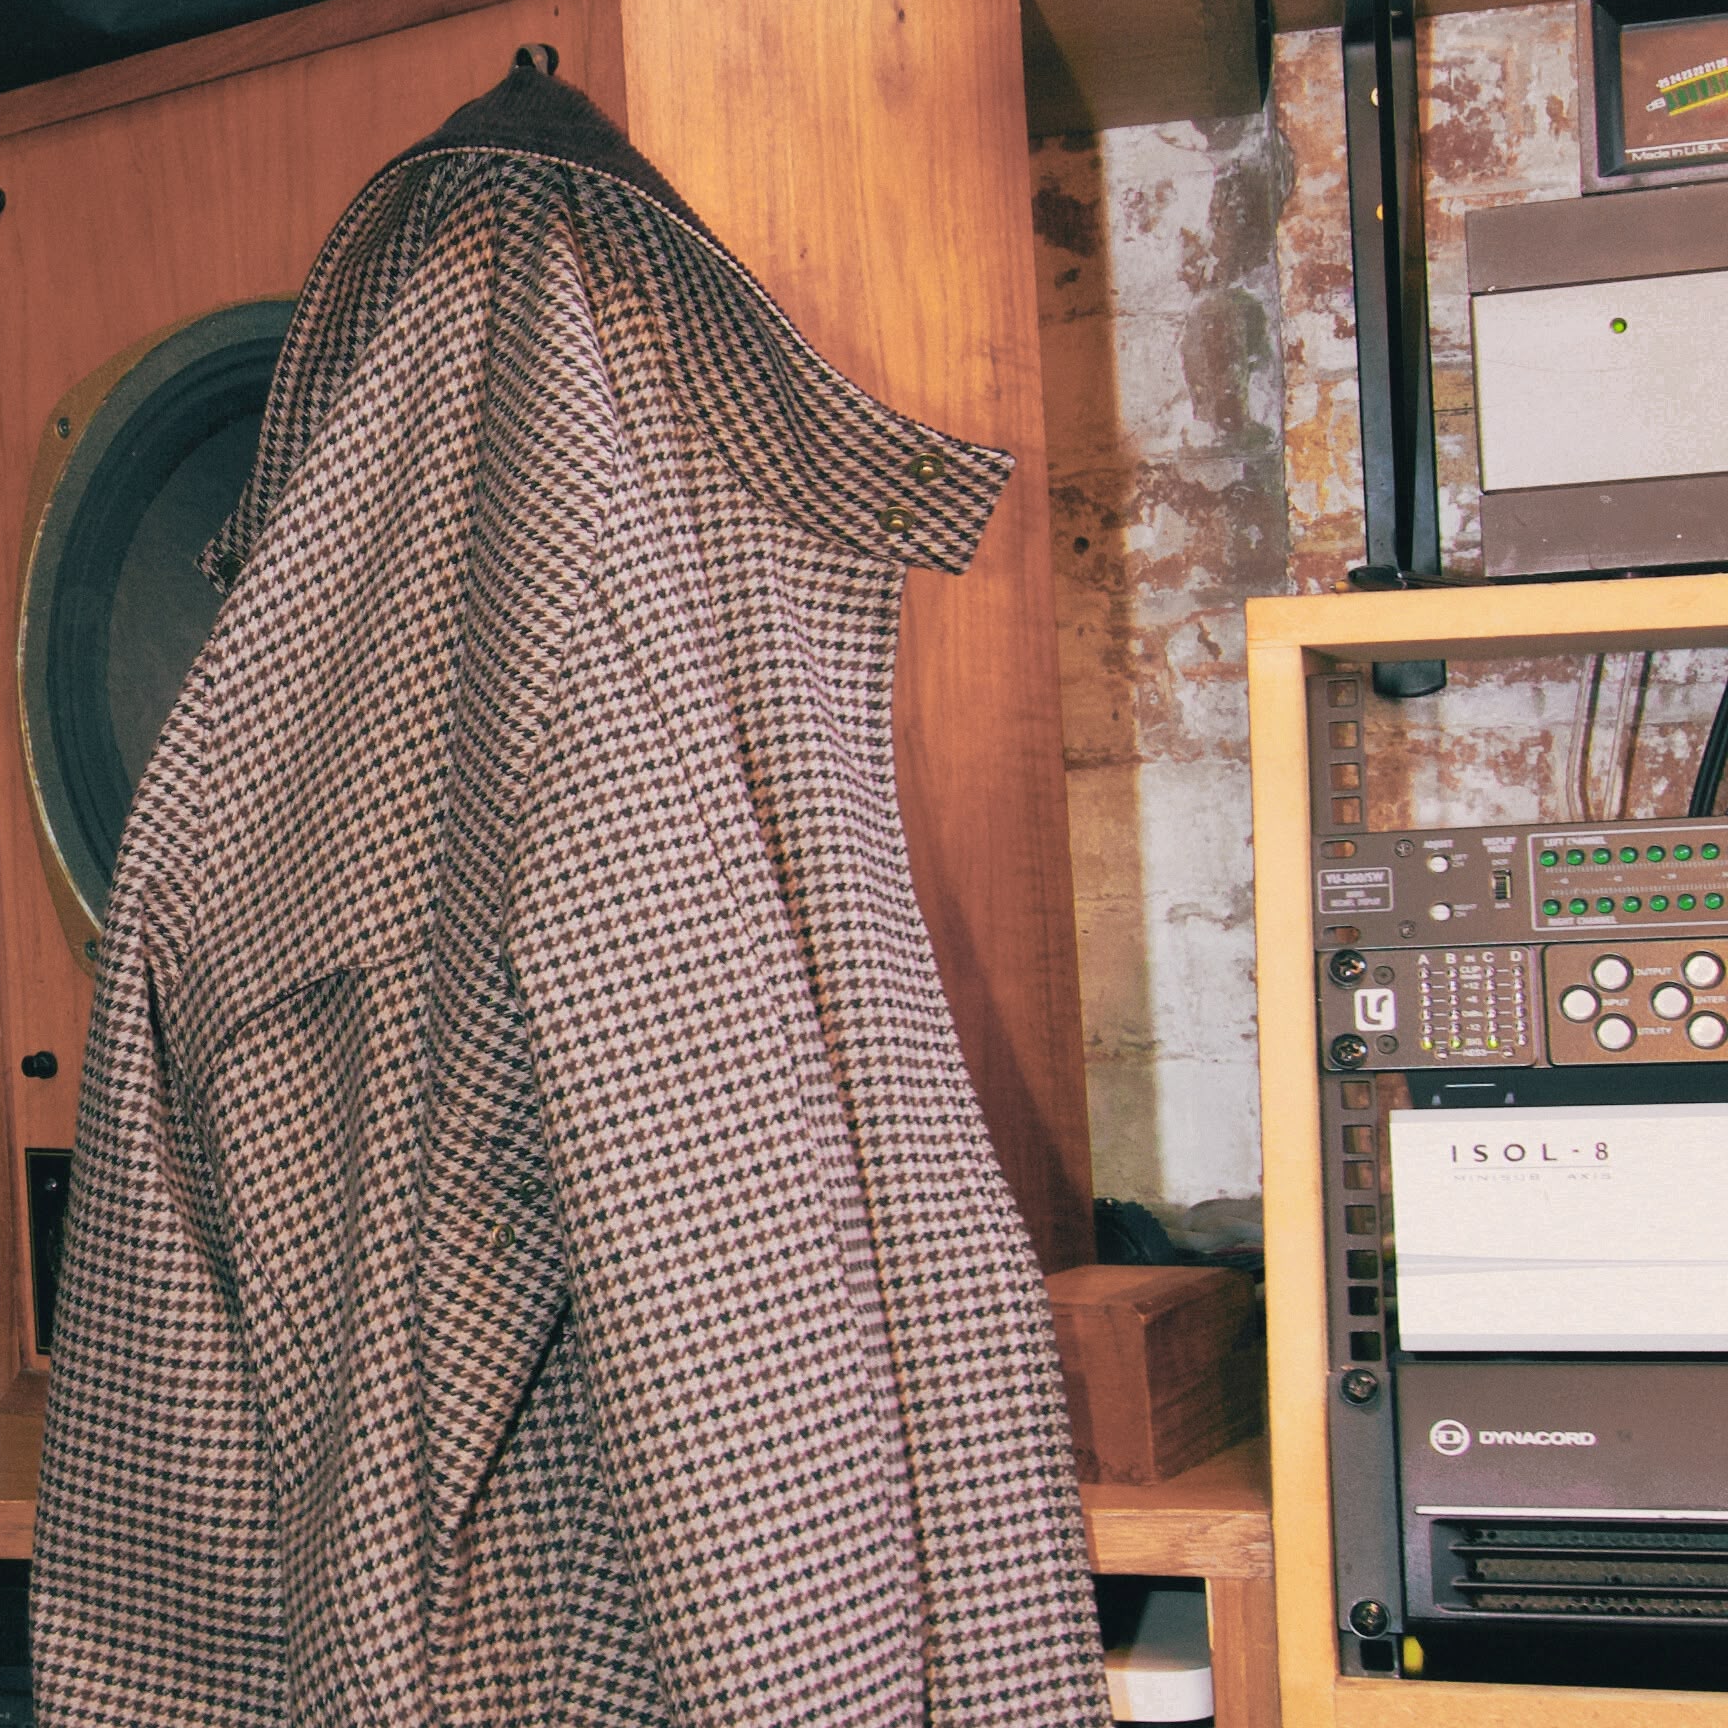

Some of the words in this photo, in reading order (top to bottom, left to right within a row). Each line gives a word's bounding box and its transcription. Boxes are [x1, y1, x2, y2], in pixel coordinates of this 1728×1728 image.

[1632, 149, 1670, 161] Made
[1417, 954, 1430, 965] A
[1445, 952, 1457, 964] B
[1482, 951, 1494, 963] C
[1510, 950, 1522, 962] D
[1633, 967, 1672, 976] OUTPUT
[1637, 1026, 1672, 1035] UTILITY
[1478, 1430, 1598, 1446] DYNACORD
